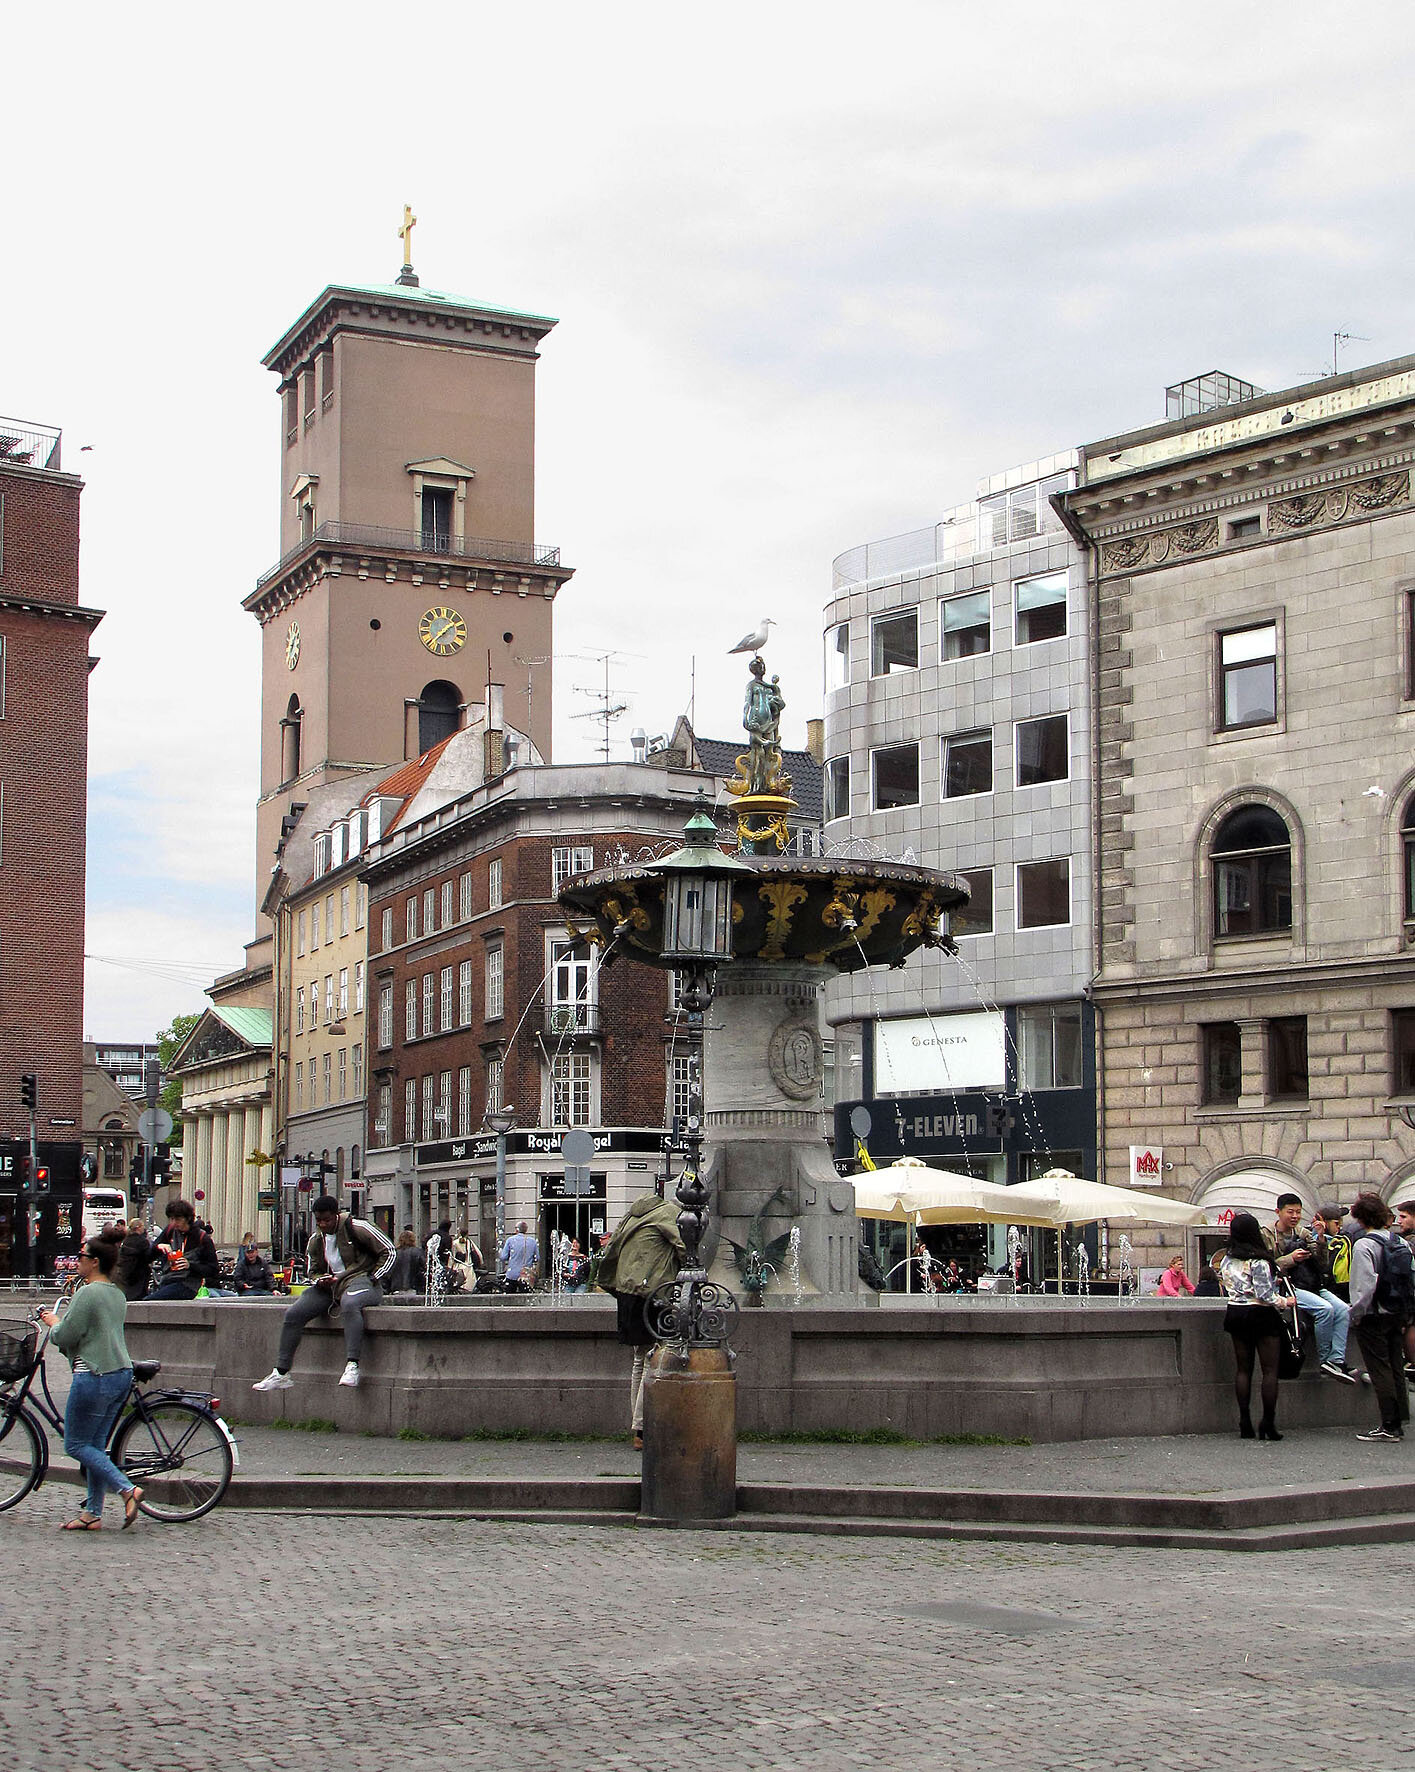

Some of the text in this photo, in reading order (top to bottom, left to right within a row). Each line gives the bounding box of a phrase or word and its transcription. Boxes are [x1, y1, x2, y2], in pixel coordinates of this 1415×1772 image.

[922, 1036, 967, 1046] GENESTA
[528, 1133, 561, 1151] Royal
[1136, 1150, 1160, 1174] MAX
